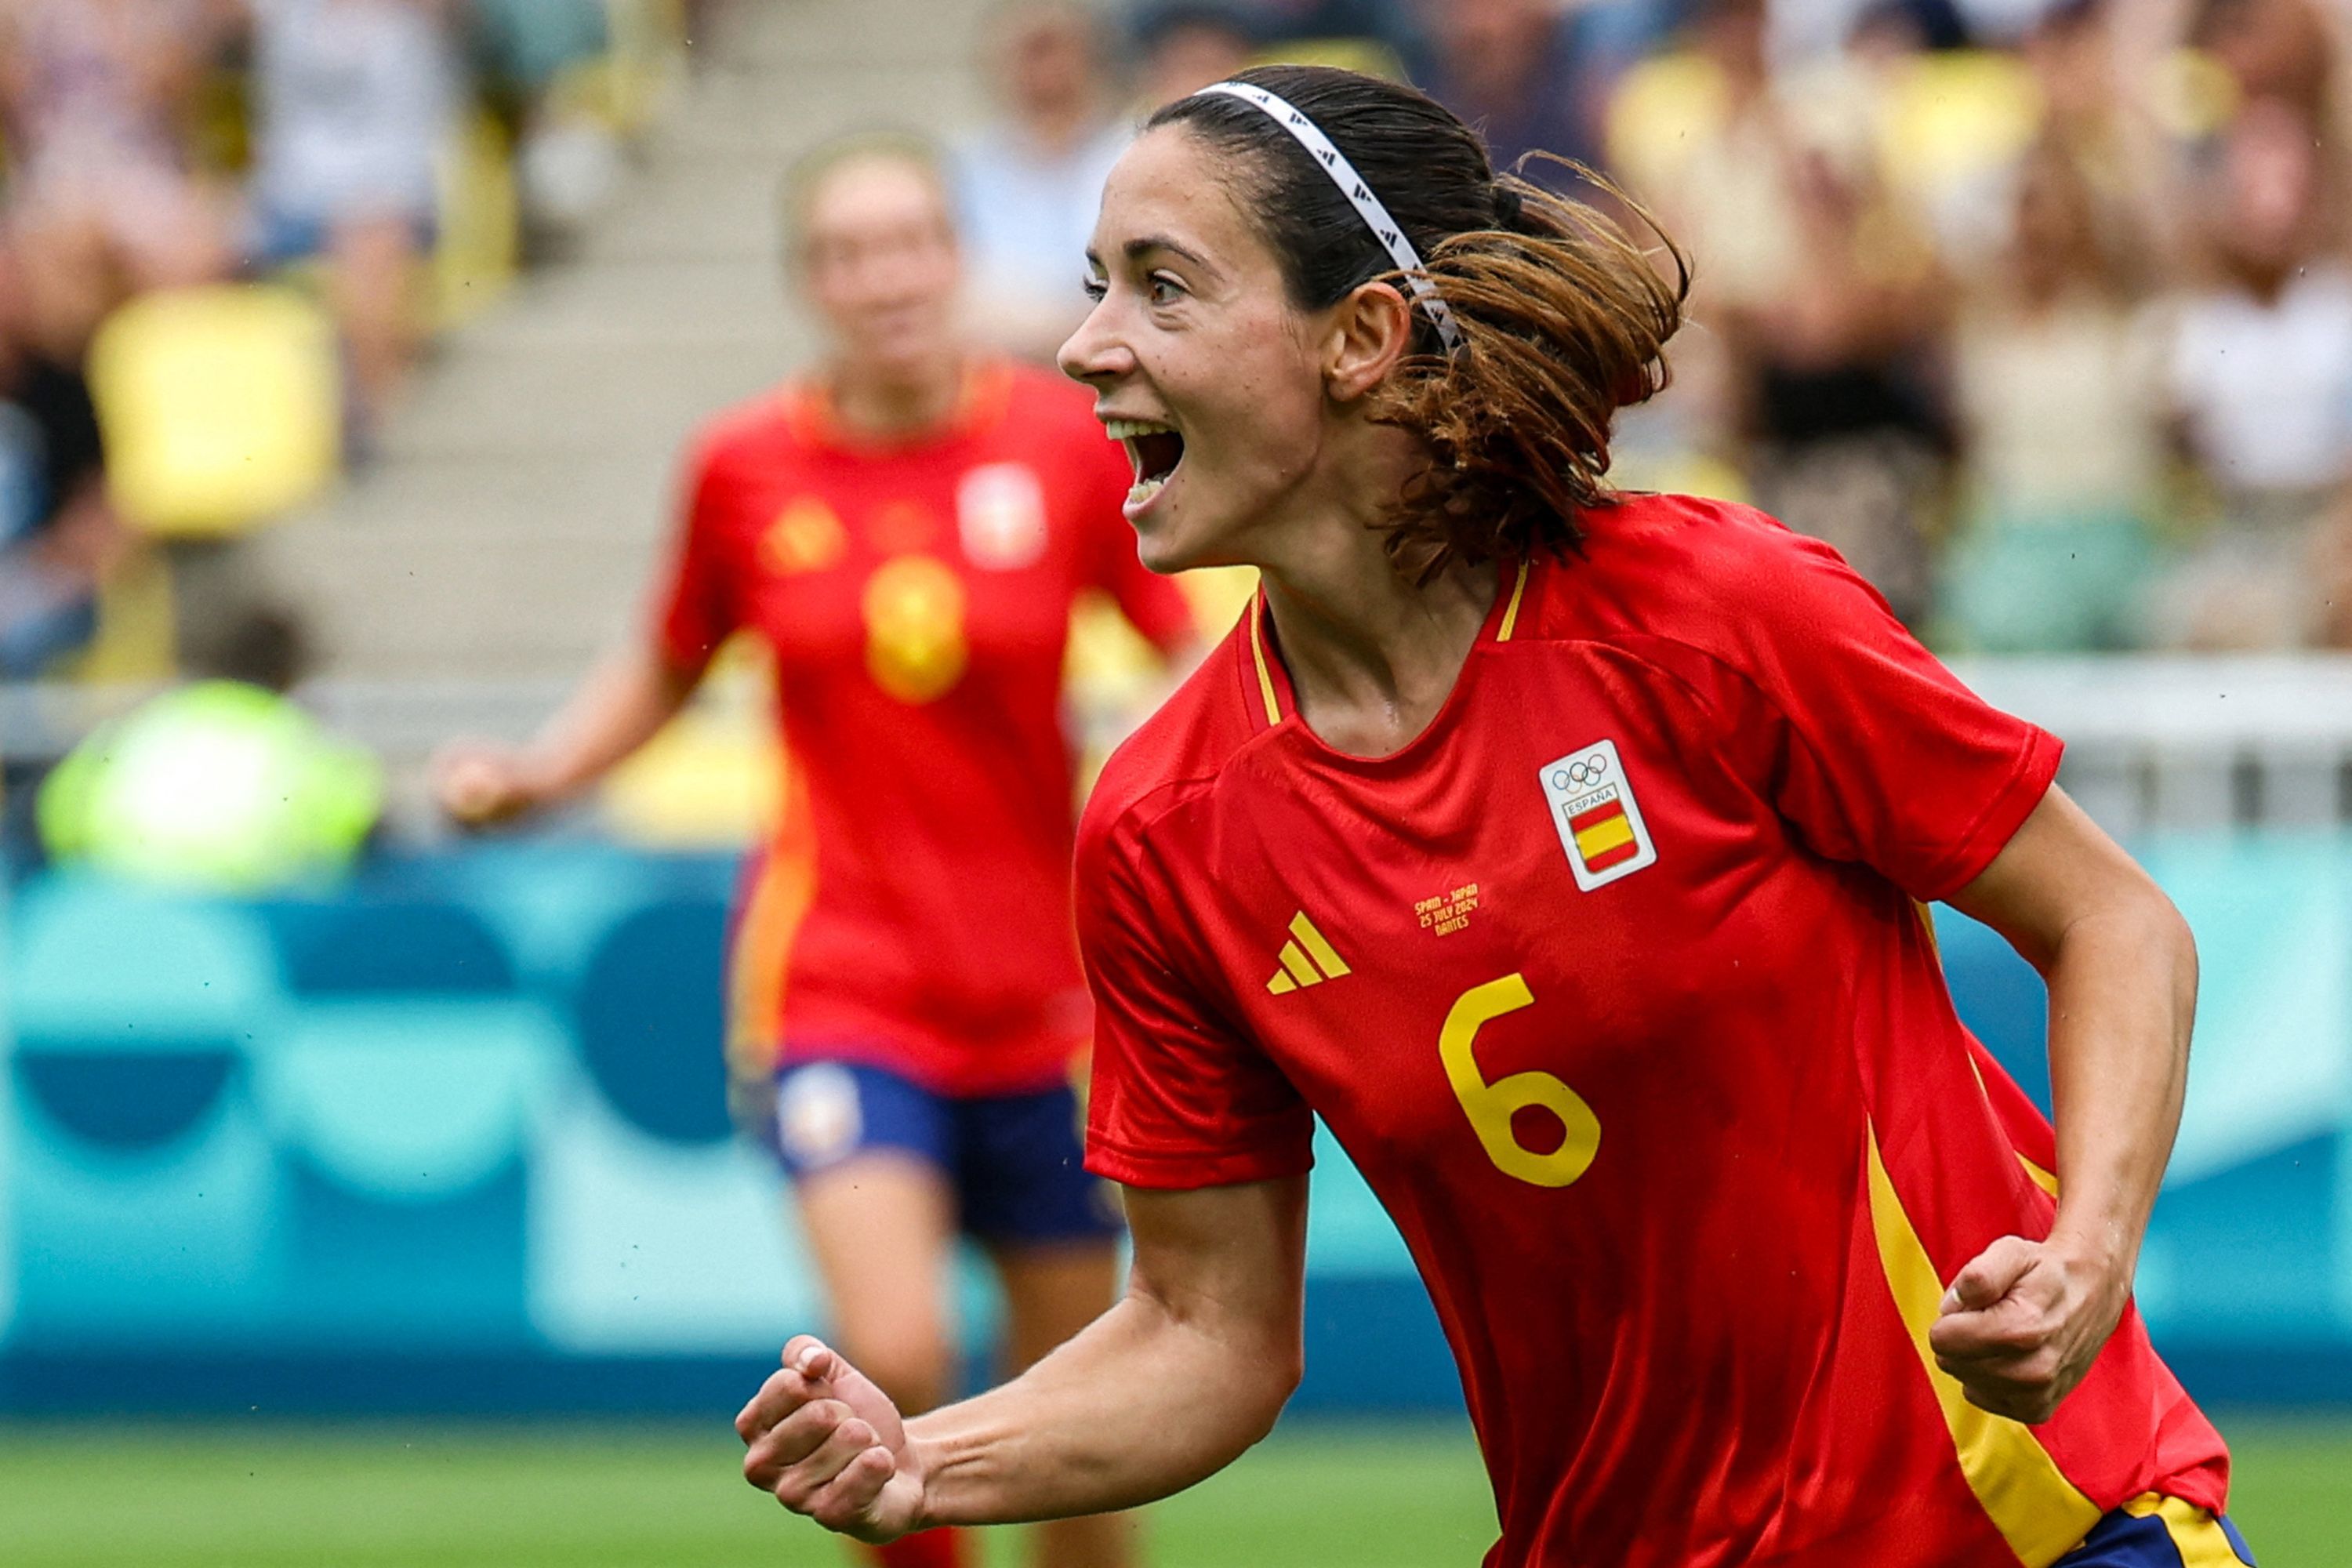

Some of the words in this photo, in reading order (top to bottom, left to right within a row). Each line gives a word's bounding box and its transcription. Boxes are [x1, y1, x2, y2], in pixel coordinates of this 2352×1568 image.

[1568, 789, 1613, 815] ESPAÑA
[1420, 913, 1432, 928] 25
[1433, 905, 1453, 923] JULY
[1454, 898, 1478, 915] 2024
[1439, 972, 1601, 1188] 6
